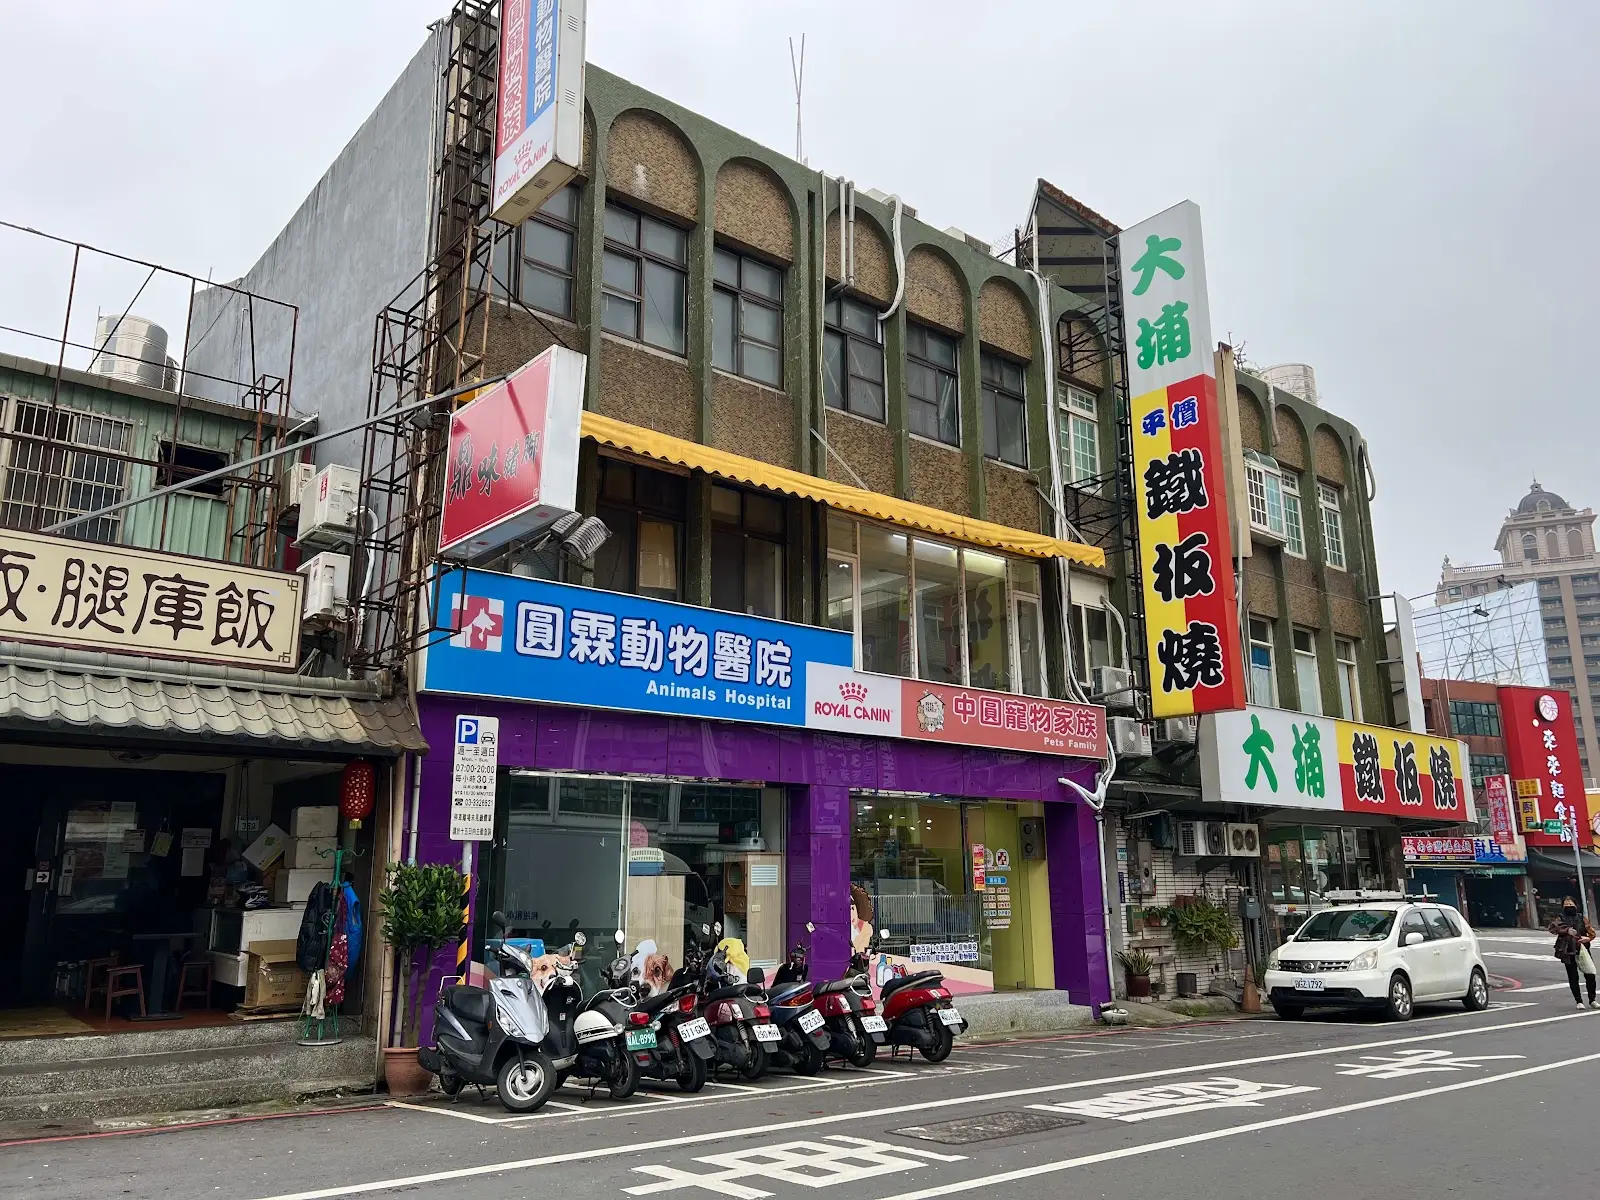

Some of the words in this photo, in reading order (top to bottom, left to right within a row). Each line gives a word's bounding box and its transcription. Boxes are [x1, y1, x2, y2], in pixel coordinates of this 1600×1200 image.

[497, 171, 522, 198] ROYAL
[520, 142, 550, 175] CANIN
[1131, 234, 1192, 370] 大埔
[1142, 396, 1199, 436] 平價
[1144, 447, 1225, 693] 鐵板燒
[515, 601, 793, 689] 圓霖動物醫院
[646, 680, 716, 701] Animals
[725, 689, 791, 710] Hospital
[814, 701, 851, 718] ROYAL
[854, 705, 891, 723] CANIN
[953, 692, 1098, 739] 中圓寵物家族
[458, 745, 495, 757] 週一至週日
[460, 720, 477, 743] P
[1044, 736, 1064, 747] Pets
[1068, 739, 1097, 751] Family
[1242, 713, 1326, 799] 大埔
[1351, 731, 1458, 811] 鐵板燒
